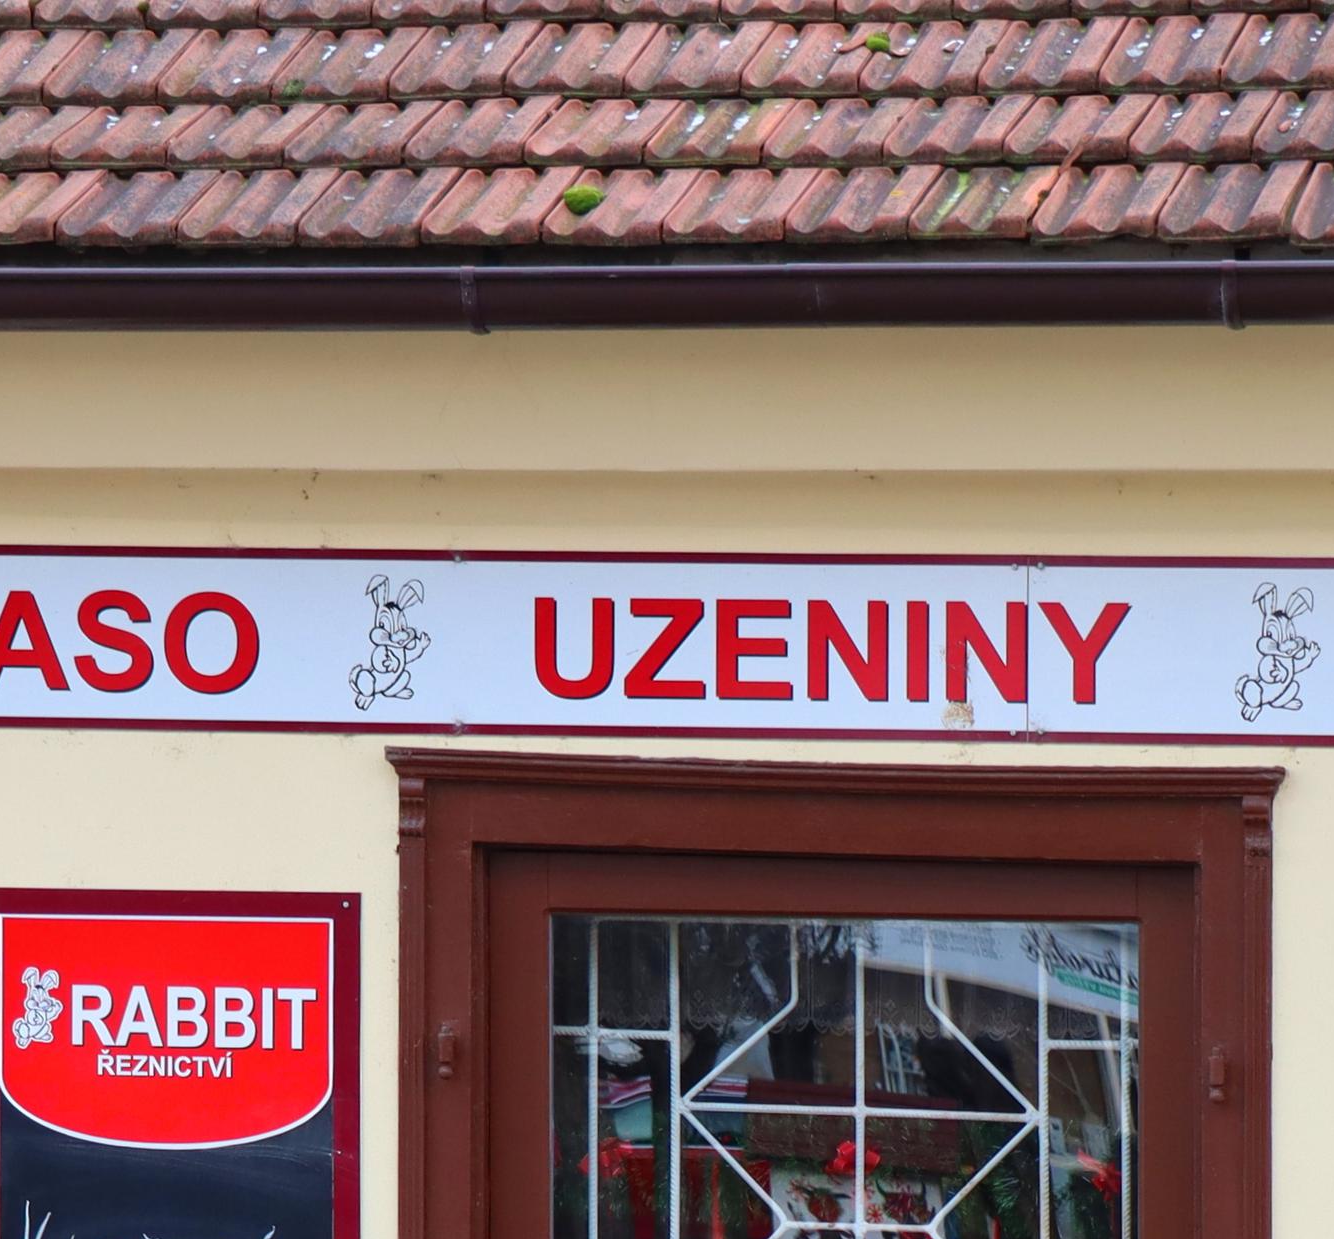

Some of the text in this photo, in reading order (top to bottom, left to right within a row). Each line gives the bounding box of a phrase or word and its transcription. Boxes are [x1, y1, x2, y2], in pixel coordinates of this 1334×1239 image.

[534, 597, 1132, 704] UZENINY
[71, 984, 317, 1050] RABBIT
[96, 1049, 233, 1078] ŘEZNICTVÍ
